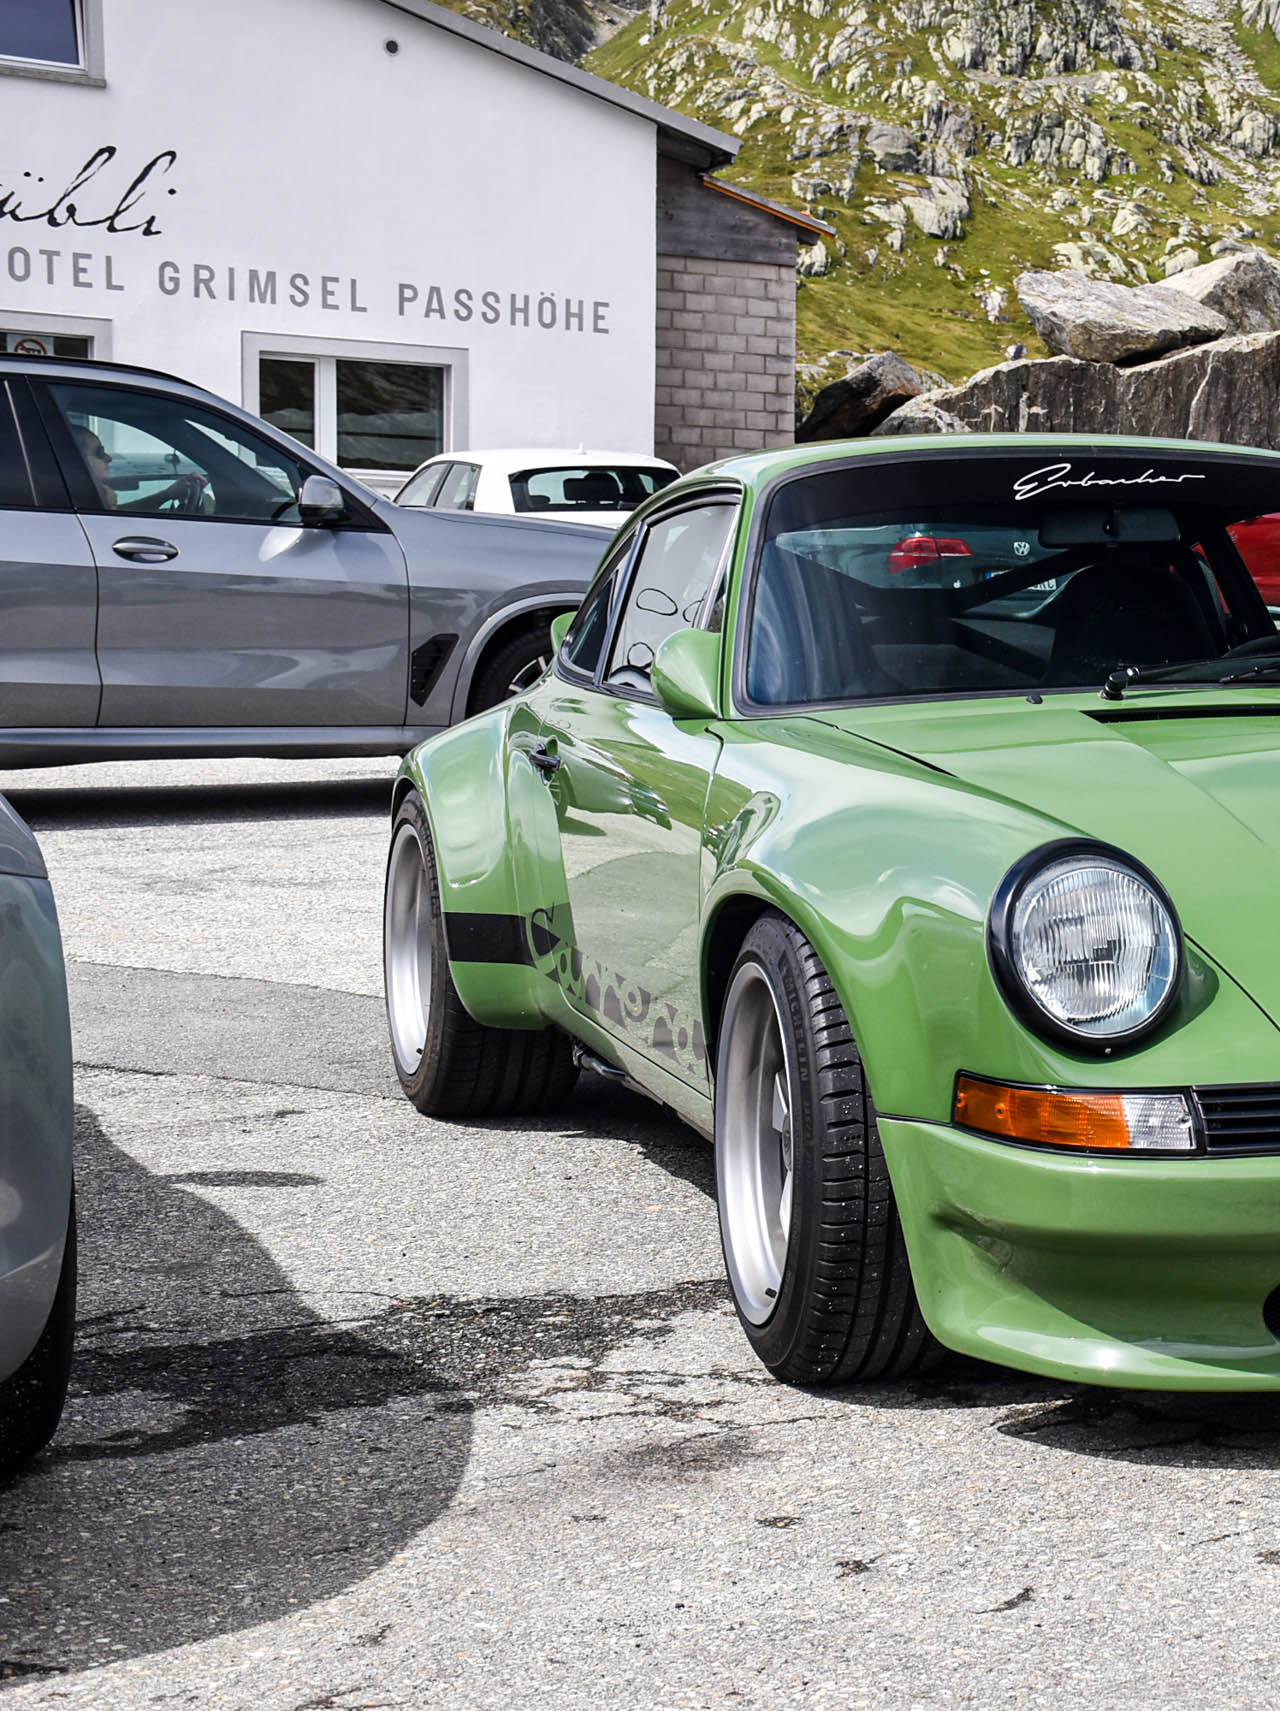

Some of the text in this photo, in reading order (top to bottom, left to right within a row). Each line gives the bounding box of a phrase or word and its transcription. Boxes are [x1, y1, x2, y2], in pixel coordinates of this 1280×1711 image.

[158, 261, 368, 313] GRIMSEL
[398, 283, 611, 334] PASSHÖHE
[783, 974, 809, 1082] MICHELIN
